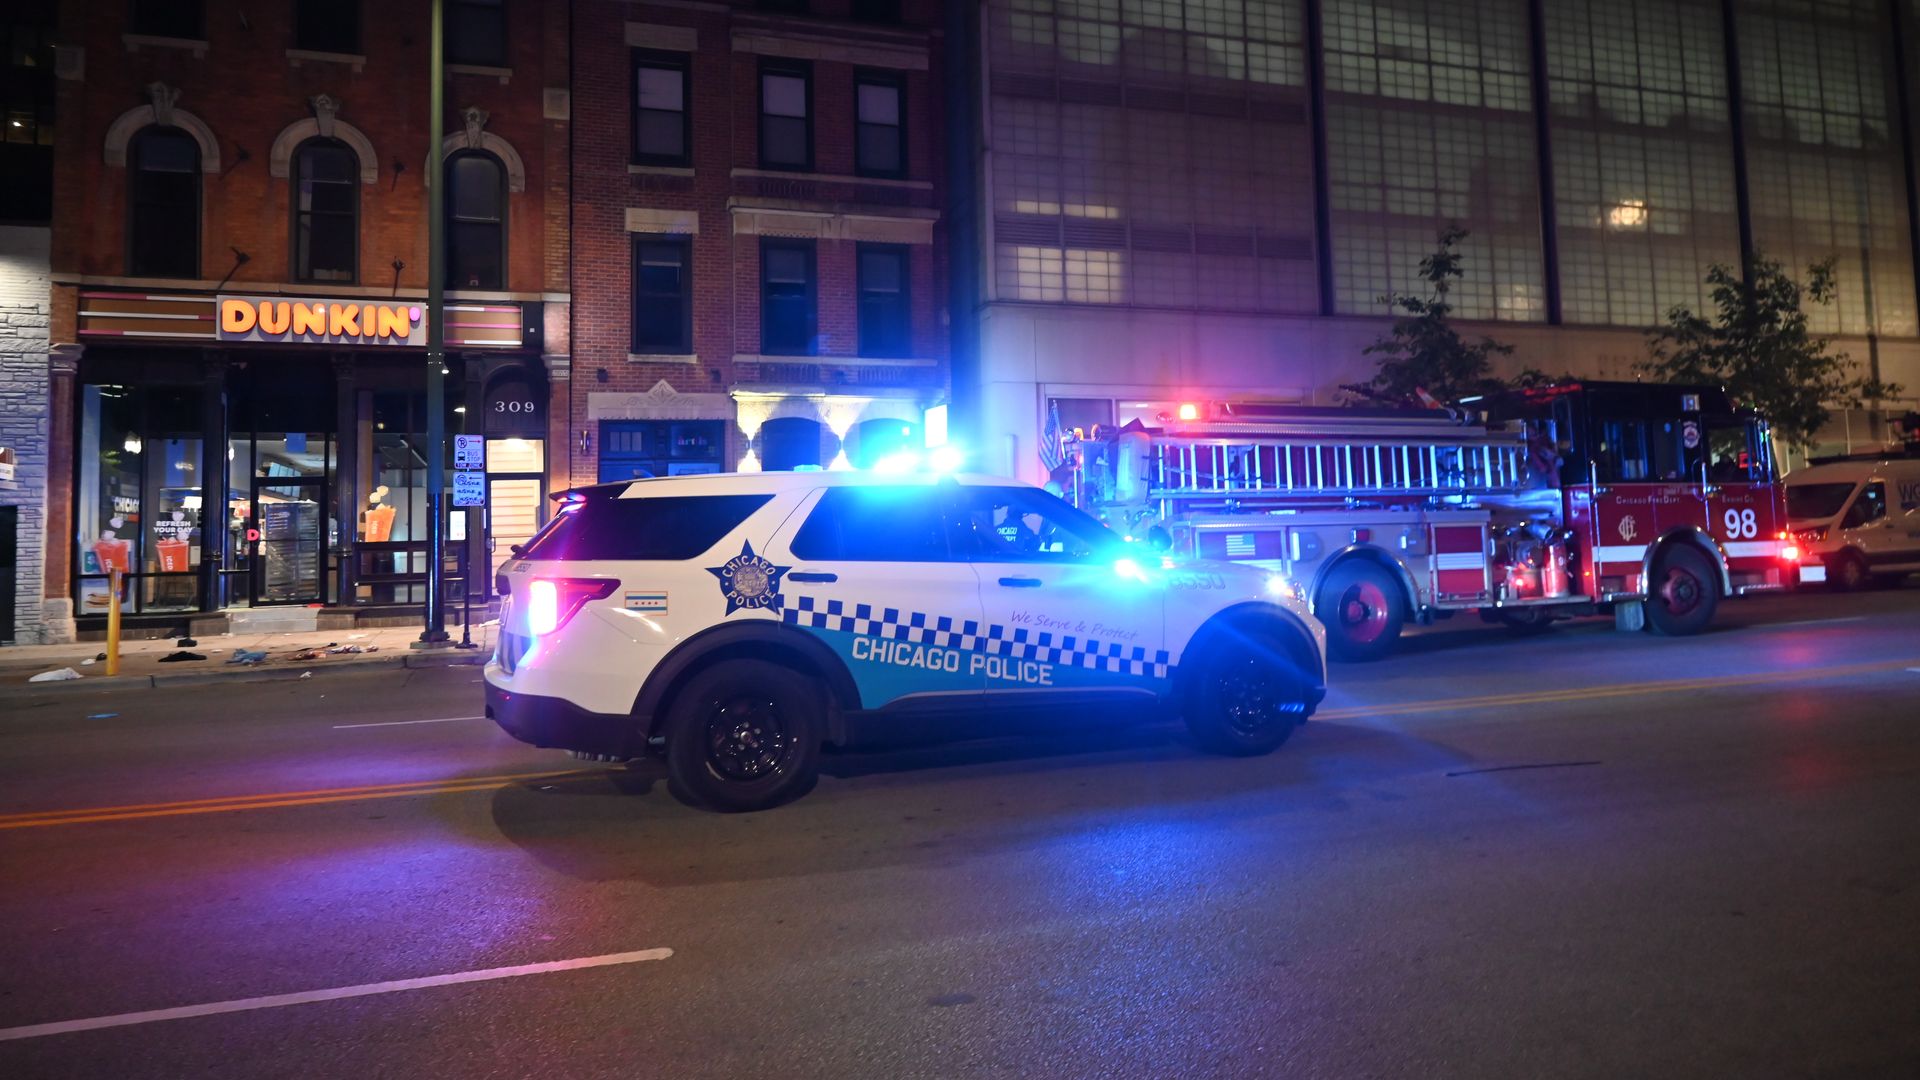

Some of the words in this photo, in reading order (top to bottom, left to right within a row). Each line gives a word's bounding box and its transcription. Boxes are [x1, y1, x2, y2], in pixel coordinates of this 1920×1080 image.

[221, 299, 420, 338] DUNKIN'
[495, 401, 534, 413] 309
[1724, 508, 1757, 539] 98
[722, 555, 776, 578] CHICAGO
[726, 586, 776, 608] POLICE
[1010, 610, 1032, 622] We
[1035, 614, 1071, 629] Serve
[1075, 621, 1086, 632] &
[1092, 623, 1138, 640] Protect
[852, 636, 960, 673] CHICAGO
[970, 653, 1054, 686] POLICE
